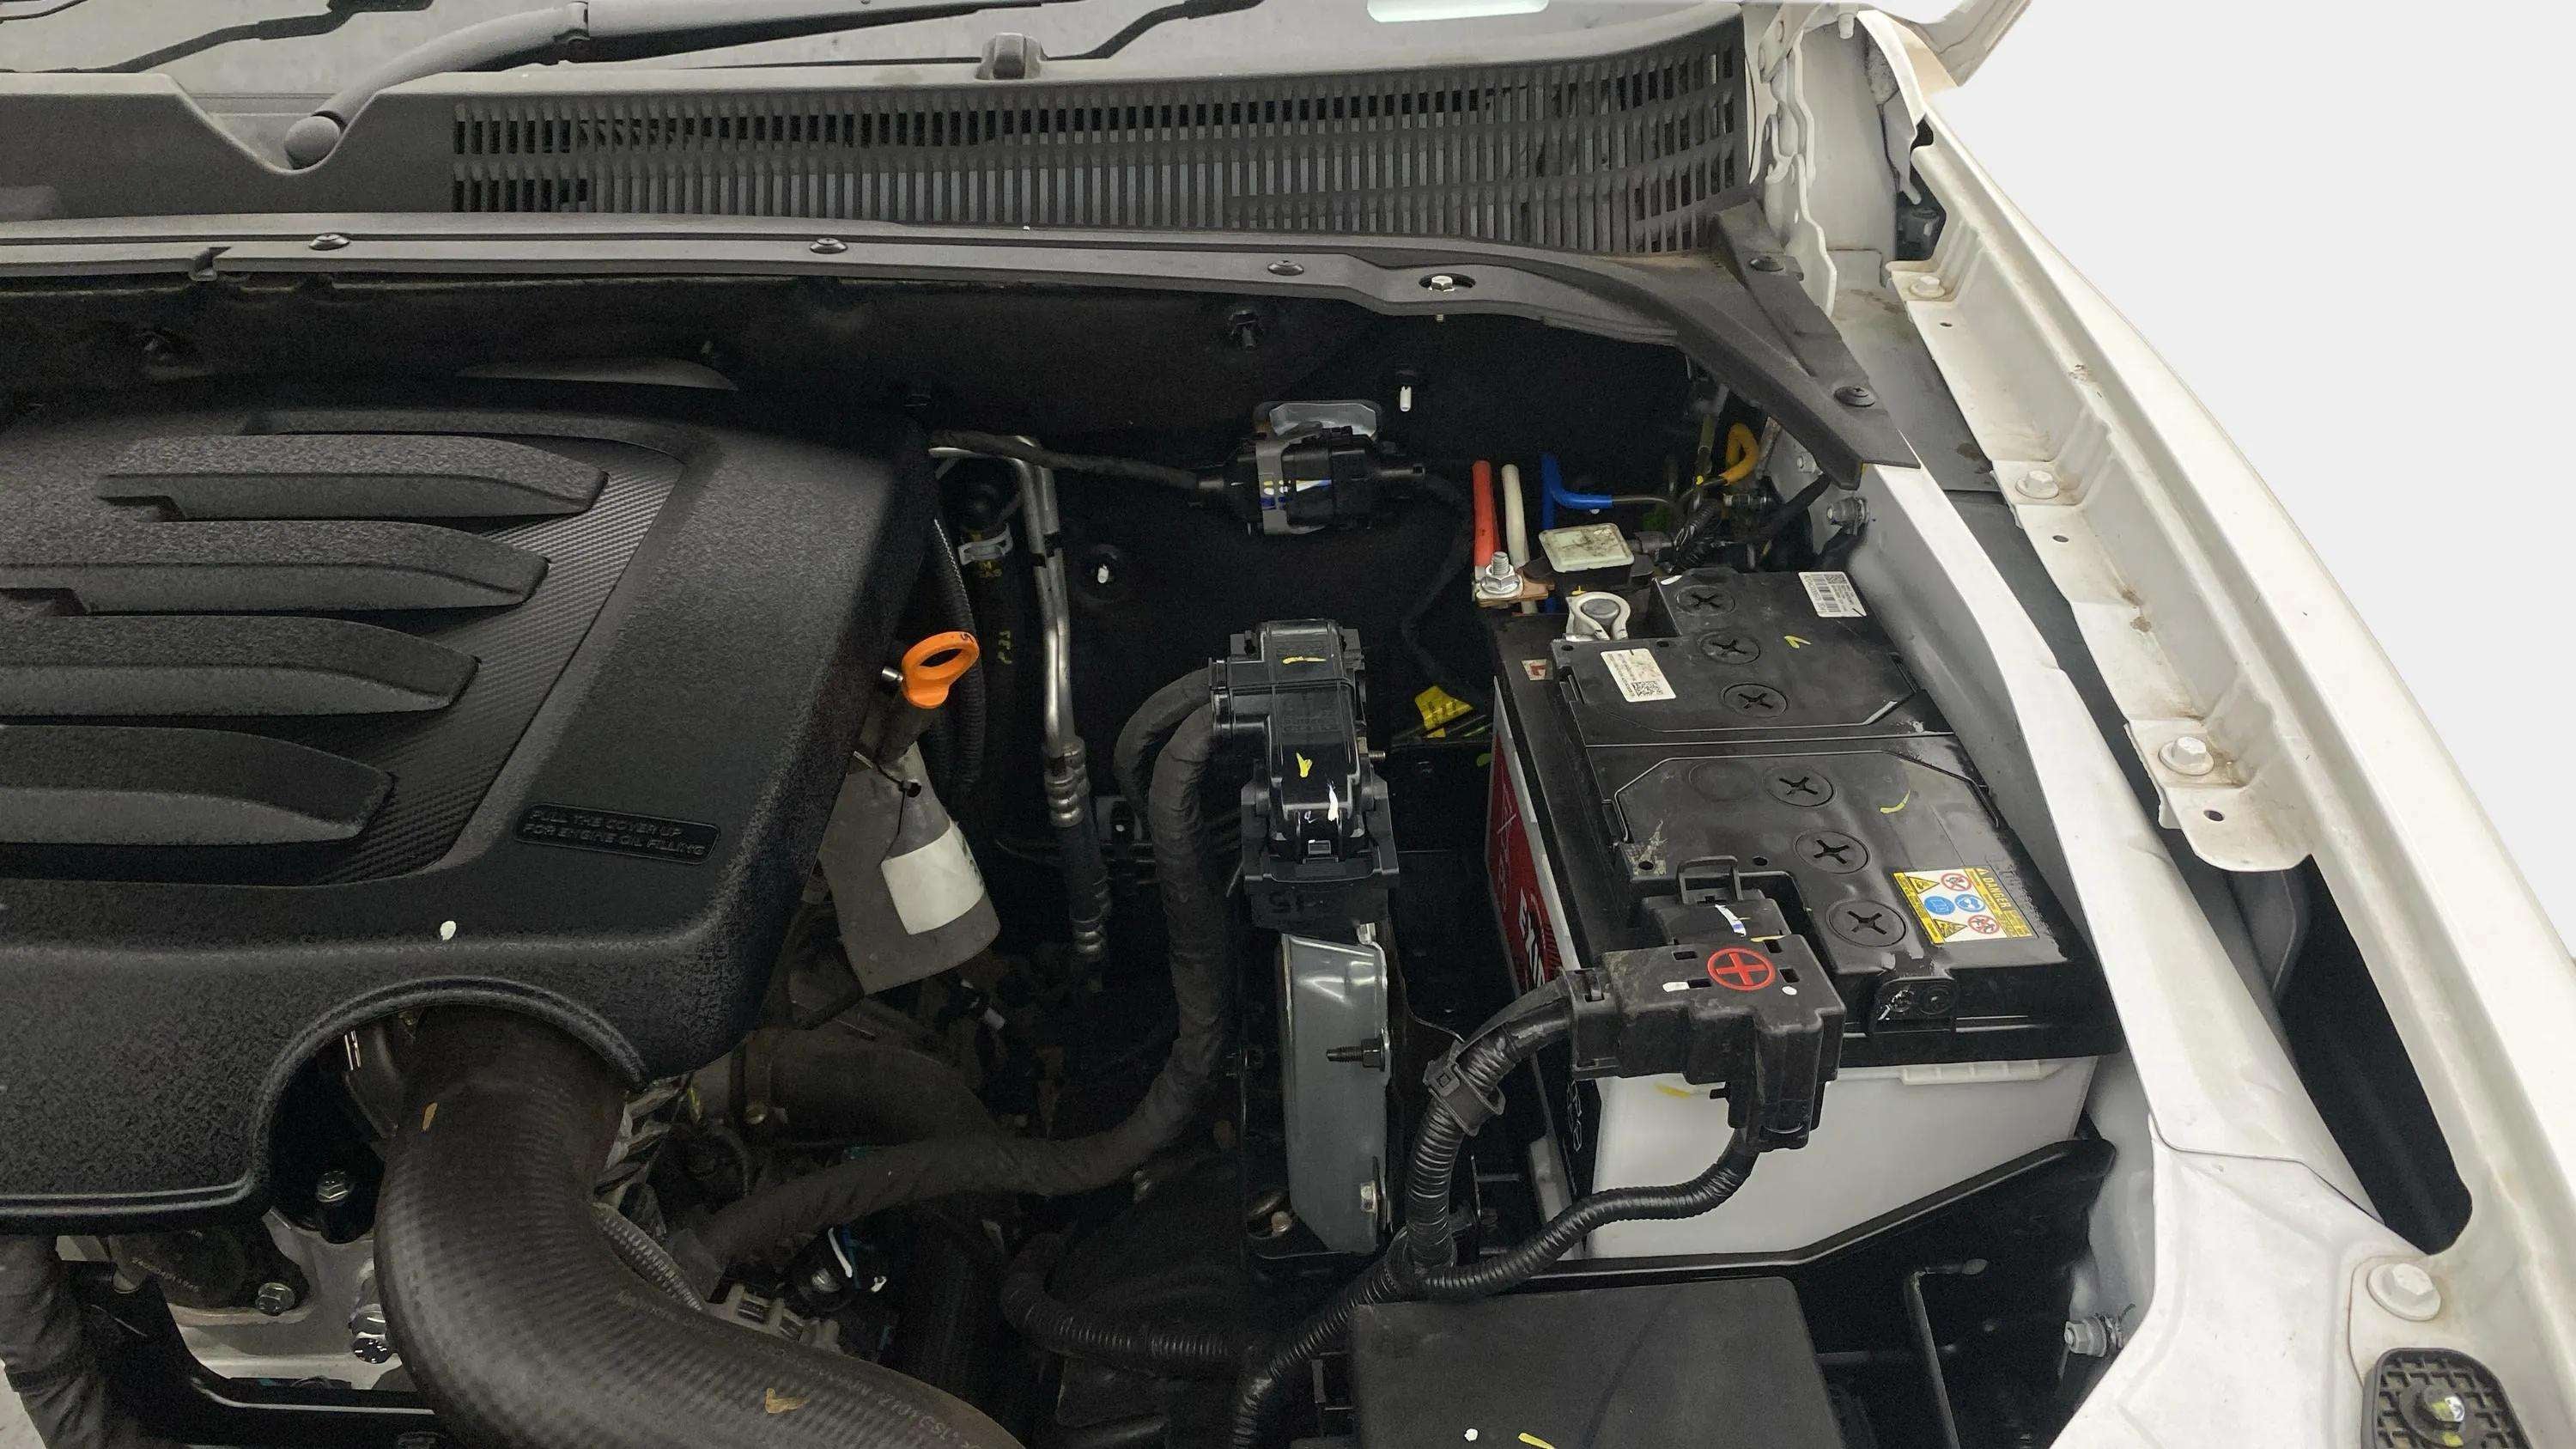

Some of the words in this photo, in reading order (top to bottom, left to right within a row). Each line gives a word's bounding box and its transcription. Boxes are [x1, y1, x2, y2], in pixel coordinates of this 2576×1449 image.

[522, 822, 557, 837] FOR
[557, 827, 617, 845] ENGINE
[618, 833, 643, 848] OIL
[647, 838, 707, 857] FILLING
[573, 813, 605, 829] THE
[605, 817, 659, 837] COVER
[1984, 877, 2013, 910] DANGER
